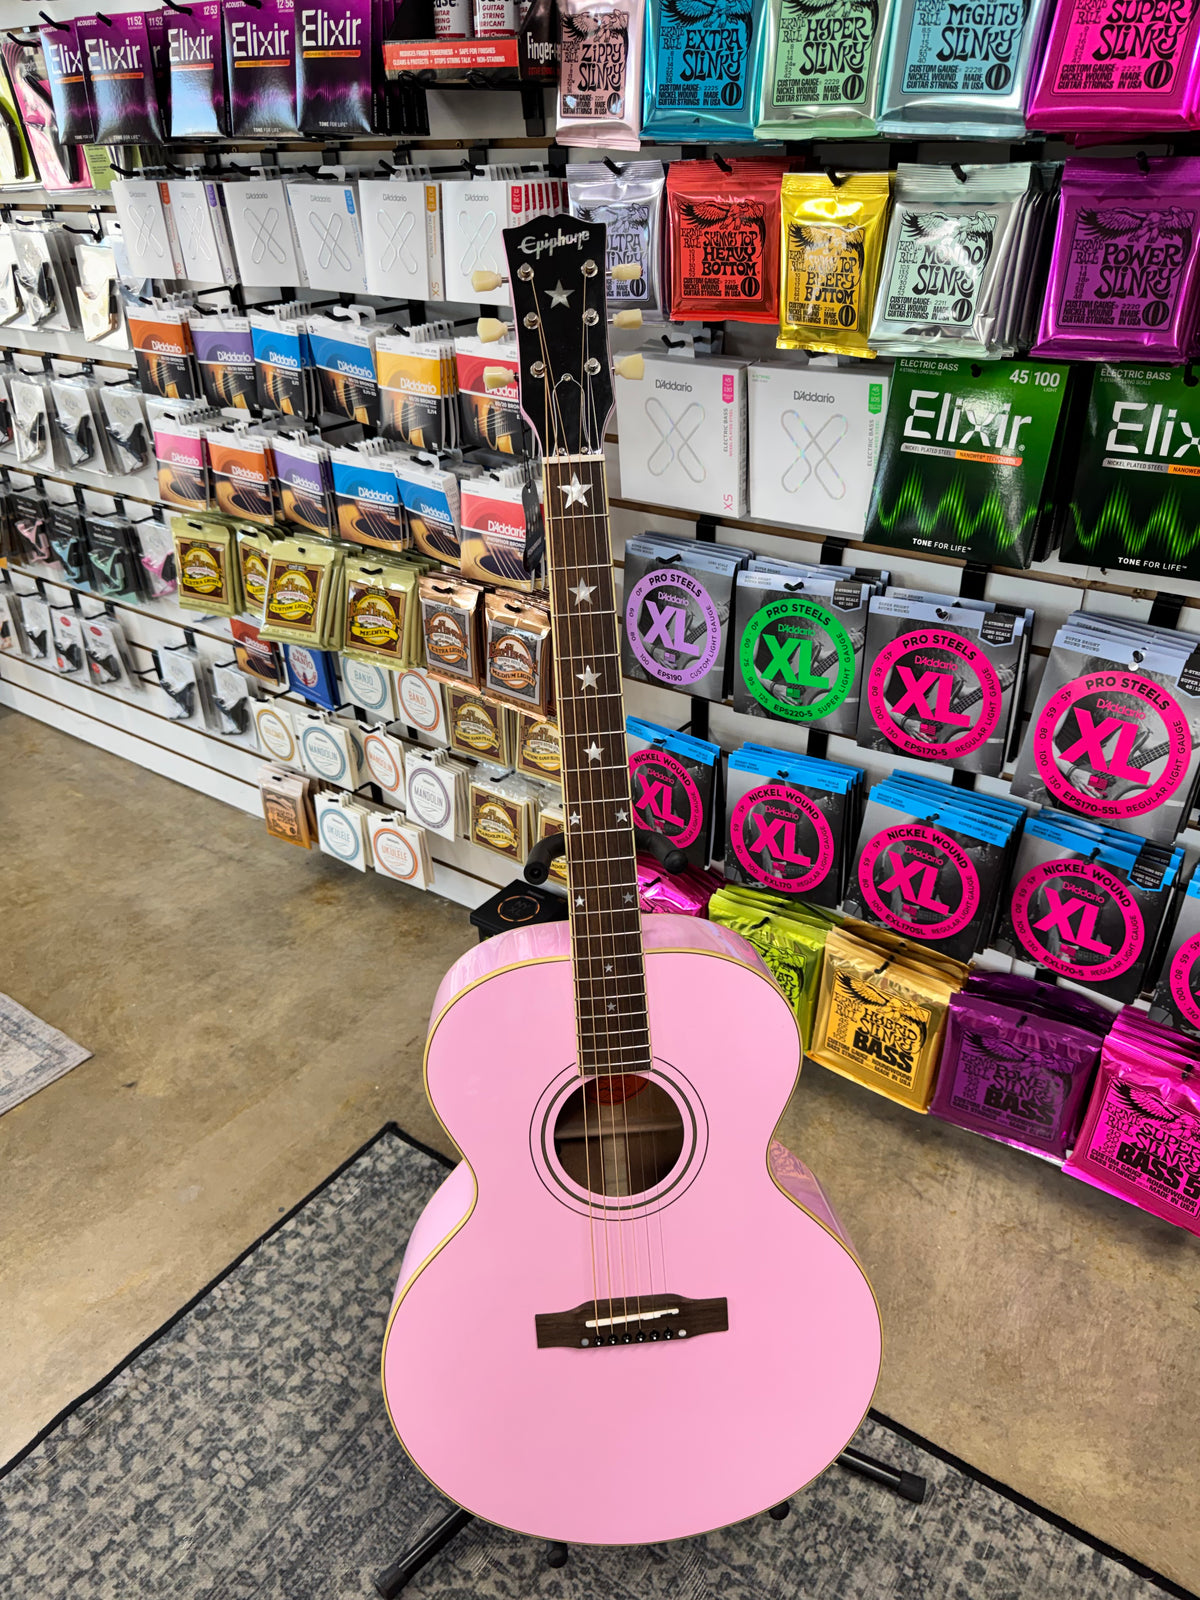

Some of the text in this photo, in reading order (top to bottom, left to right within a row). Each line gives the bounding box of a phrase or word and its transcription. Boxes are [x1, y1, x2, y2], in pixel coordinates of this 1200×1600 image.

[946, 4, 1021, 26] MIGHTY
[1105, 0, 1188, 24] SUPER
[302, 10, 362, 47] Elixir
[805, 16, 872, 42] HYPER
[170, 23, 215, 62] Elixir
[233, 22, 291, 58] Elixir
[685, 28, 742, 52] EXTRA
[935, 25, 1020, 62] SLINKY
[1091, 24, 1183, 61] SLINKY
[85, 38, 144, 71] Elixir
[581, 42, 623, 64] ZIPPY
[798, 39, 870, 77] SLINKY
[678, 47, 745, 82] SLINKY
[908, 65, 959, 73] CUSTOM GAUGE
[1061, 64, 1116, 73] CUSTOM GAUGE
[577, 61, 624, 92] SLINKY
[658, 83, 700, 91] CUSTOM GAUGE
[777, 79, 820, 87] CUSTOM GAUGE
[906, 81, 958, 89] GUITAR STRINGS
[932, 73, 956, 81] WOUND
[964, 74, 983, 82] MADE
[1120, 72, 1142, 80] MADE
[517, 228, 590, 260] Epiphone
[703, 229, 758, 248] SKINNY TOP
[702, 246, 757, 262] HEAVY
[1101, 243, 1182, 267] POWER
[701, 261, 758, 276] BOTTOM
[1093, 265, 1176, 298] SLINKY
[804, 287, 856, 305] BOTTOM
[151, 341, 182, 354] D'Addario
[217, 351, 252, 364] D'Addario
[269, 351, 299, 367] D'Addario
[337, 360, 373, 380] D'Addario
[900, 359, 960, 373] ELECTRIC BASS
[400, 377, 437, 394] D'Addario
[1009, 368, 1061, 387] 45 100
[1100, 368, 1172, 381] ELECTRIC BASS
[655, 379, 693, 393] D'Addario
[793, 390, 835, 405] D'Addario
[903, 389, 1033, 451] Elixir
[172, 452, 200, 466] D'Addario
[904, 445, 953, 458] NICKEL PLATED STEEL
[232, 465, 264, 481] D'Addario
[1107, 459, 1164, 472] NICKEL PLATED STEEL
[292, 474, 320, 491] D'Addario
[358, 486, 395, 503] D'Addario
[723, 493, 734, 511] XS
[421, 503, 451, 522] D'Addario
[912, 537, 972, 554] TONE FOR LIFE
[1118, 557, 1187, 574] TONE FOR LIFE
[649, 573, 703, 599] PRO STEELS
[270, 602, 313, 613] CUSTOM LIGHT
[658, 591, 690, 606] D'Addario
[705, 604, 719, 635] GAUGE
[766, 603, 831, 627] PRO STEELS
[358, 627, 391, 637] MEDIUM
[643, 599, 700, 657] XL
[777, 623, 817, 638] D'Addario
[689, 636, 718, 680] CUSTOM LIGHT
[902, 633, 978, 662] PRO STEELS
[760, 632, 830, 690] XL
[914, 655, 959, 672] D'Addario
[354, 671, 373, 686] BANJO
[491, 668, 516, 680] MEDIUM
[657, 669, 683, 683] EPS190
[817, 632, 852, 715] SUPER LIGHT GAUGE
[408, 691, 427, 705] BANJO
[890, 664, 971, 728] XL
[1085, 675, 1117, 692] PRO
[1119, 676, 1170, 711] STEELS
[773, 703, 814, 718] EPS220-5
[954, 666, 998, 755] REGULAR LIGHT GAUGE
[1096, 698, 1146, 721] D'Addario
[904, 739, 948, 757] EPS170-5
[1057, 705, 1152, 786] XL
[633, 752, 691, 787] NICKEL WOUND
[1125, 719, 1186, 815] REGULAR LIGHT GAUGE
[635, 771, 685, 829] XL
[748, 788, 820, 820] NICKEL WOUND
[1063, 790, 1122, 816] EPS170-5SL
[765, 804, 801, 820] D'Addario
[749, 811, 812, 868] XL
[887, 828, 969, 869] NICKEL WOUND
[381, 844, 408, 862] UKULELE
[904, 845, 944, 866] D'Addario
[763, 876, 793, 890] EXL170
[877, 849, 951, 916] XL
[1043, 863, 1132, 908] NICKEL WOUND
[1062, 881, 1106, 904] D'Addario
[885, 913, 927, 937] EXL170SL
[1032, 885, 1112, 957] XL
[1043, 954, 1085, 977] EXL170-5
[1175, 986, 1187, 1003] 100
[1186, 1005, 1199, 1020] 130
[858, 1017, 915, 1055] SLINKY
[862, 1007, 918, 1044] HYBRID
[852, 1030, 914, 1074] BASS
[984, 1085, 1057, 1126] BASS
[1091, 1148, 1143, 1179] CUSTOM GAUGE
[1116, 1141, 1200, 1200] BASS 5
[1146, 1177, 1198, 1208] ROUNDWOUND
[1149, 1185, 1196, 1213] MADE IN USA
